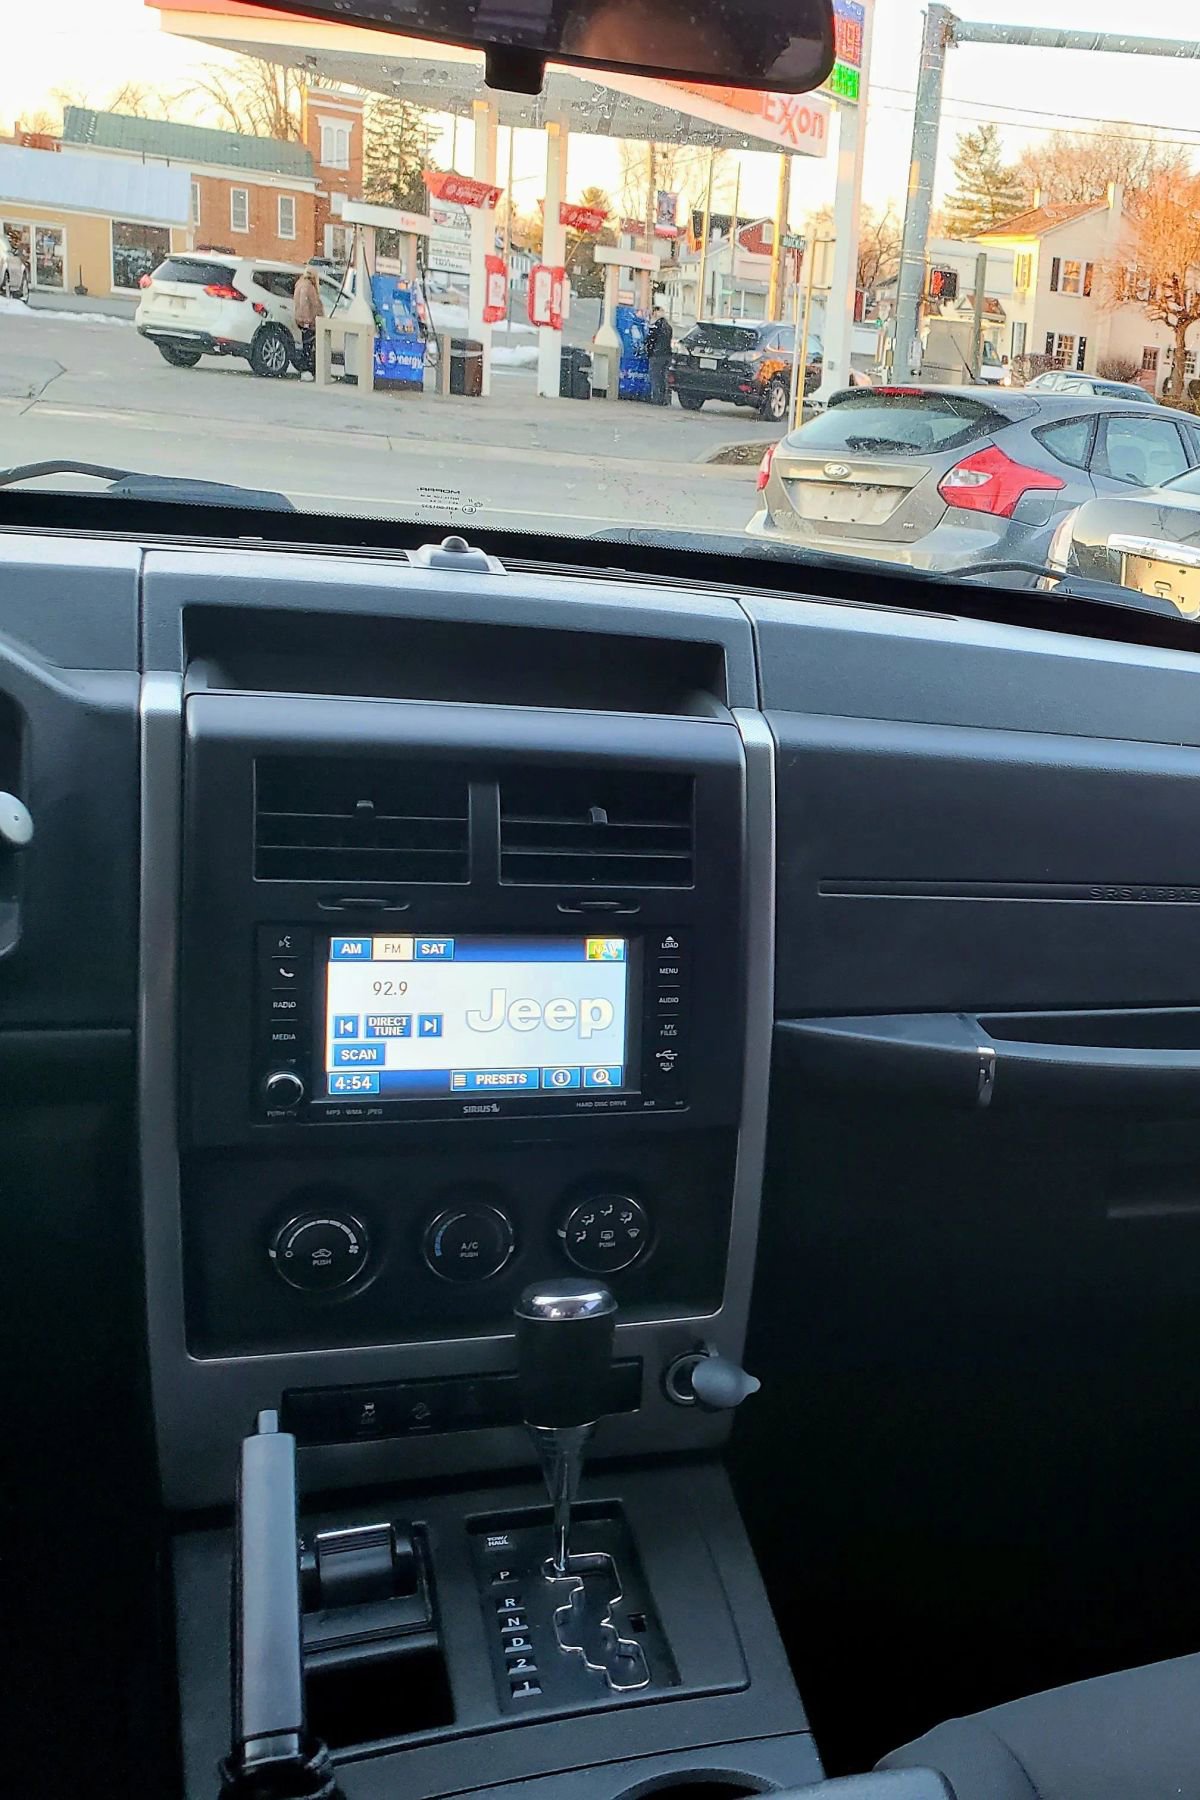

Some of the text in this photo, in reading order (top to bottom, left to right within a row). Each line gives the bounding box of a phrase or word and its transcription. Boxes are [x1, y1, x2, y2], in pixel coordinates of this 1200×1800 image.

[1089, 887, 1132, 899] SRS
[341, 944, 362, 954] AM
[384, 944, 401, 954] FM
[421, 944, 447, 954] SAT
[592, 944, 618, 956] NAV
[372, 981, 408, 996] 92.9
[272, 1001, 296, 1009] RADIO
[465, 988, 614, 1039] Jeep
[368, 1016, 409, 1027] DIRECT
[374, 1026, 404, 1036] TUNE
[341, 1049, 377, 1060] SCAN
[334, 1076, 372, 1089] 4:54
[476, 1073, 527, 1085] PRESETS
[463, 1104, 491, 1114] SIRIUS
[461, 1242, 478, 1250] A/C
[500, 1571, 510, 1580] P
[505, 1598, 516, 1607] R
[508, 1617, 520, 1627] N
[512, 1637, 524, 1647] D
[517, 1658, 527, 1667] 2
[522, 1682, 530, 1690] 1
